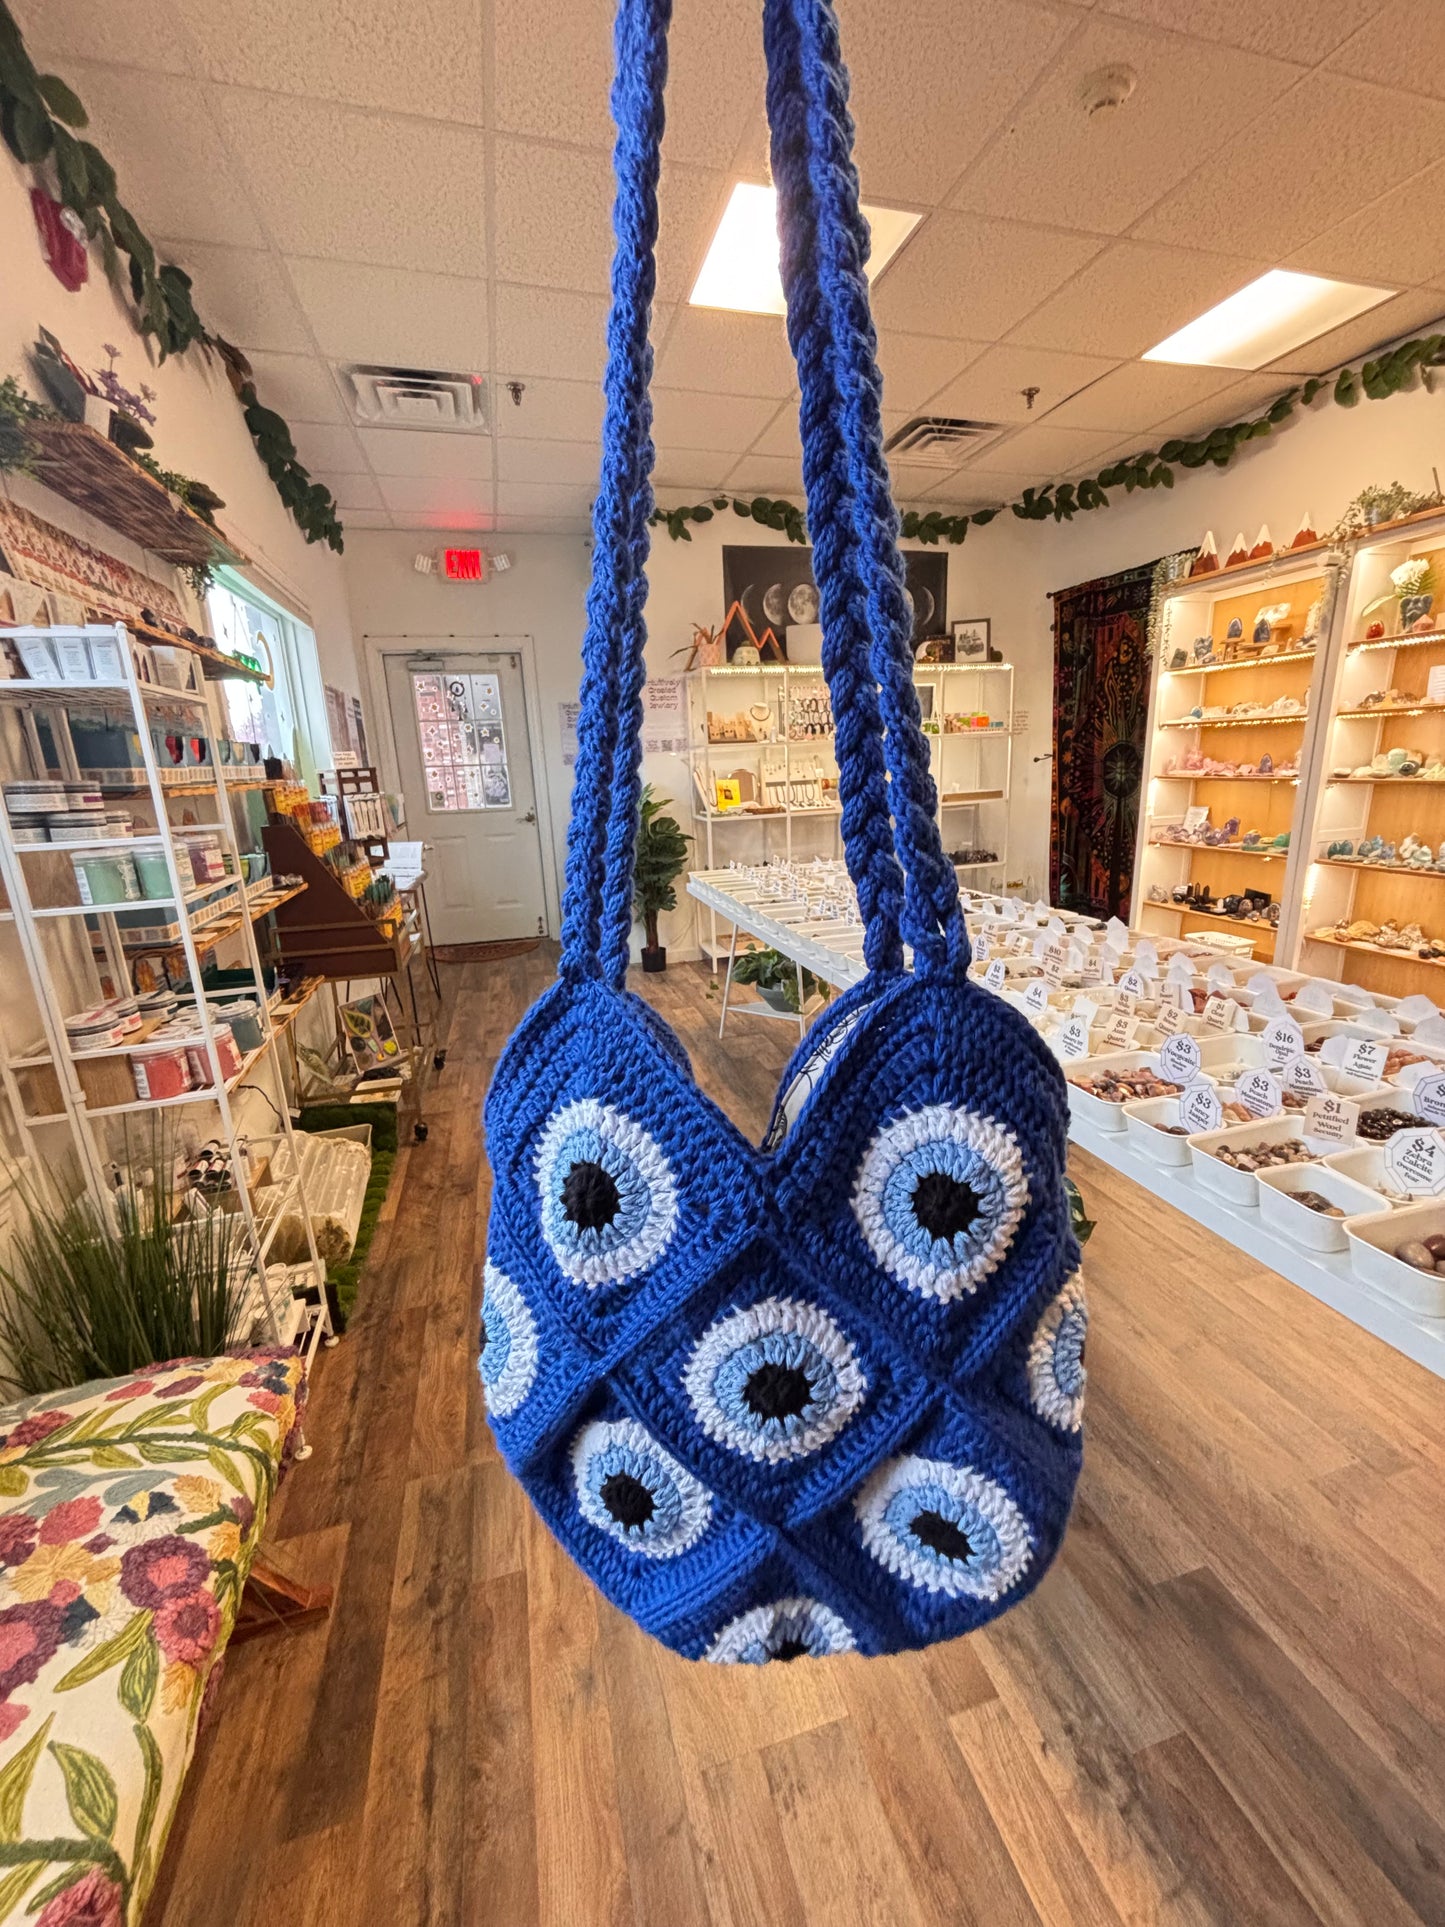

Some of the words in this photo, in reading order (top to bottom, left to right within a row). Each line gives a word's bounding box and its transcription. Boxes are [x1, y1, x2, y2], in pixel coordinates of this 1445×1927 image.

[446, 550, 481, 579] EXIT
[1069, 1024, 1081, 1038] $3
[1116, 1018, 1128, 1029] $3
[1275, 1030, 1294, 1044] $16
[1176, 1040, 1191, 1055] $3
[1358, 1043, 1376, 1055] $7
[1352, 1053, 1377, 1064] Flower
[1352, 1061, 1373, 1070] Agate
[1295, 1065, 1311, 1078] $3
[1252, 1075, 1269, 1091] $3
[1294, 1078, 1314, 1086] Peach
[1195, 1092, 1211, 1109] $3
[1241, 1090, 1275, 1110] Moonstone
[1249, 1087, 1268, 1100] Peach
[1191, 1103, 1210, 1120] Fancy
[1323, 1099, 1342, 1114] $1
[1188, 1109, 1209, 1126] Jasper
[1312, 1111, 1350, 1126] Petrified
[1313, 1127, 1344, 1140] Security
[1317, 1120, 1342, 1133] Wood
[1412, 1137, 1436, 1158] $4
[1402, 1156, 1433, 1175] Calcite
[1405, 1149, 1433, 1167] Zebra
[1396, 1161, 1433, 1183] Overcome
